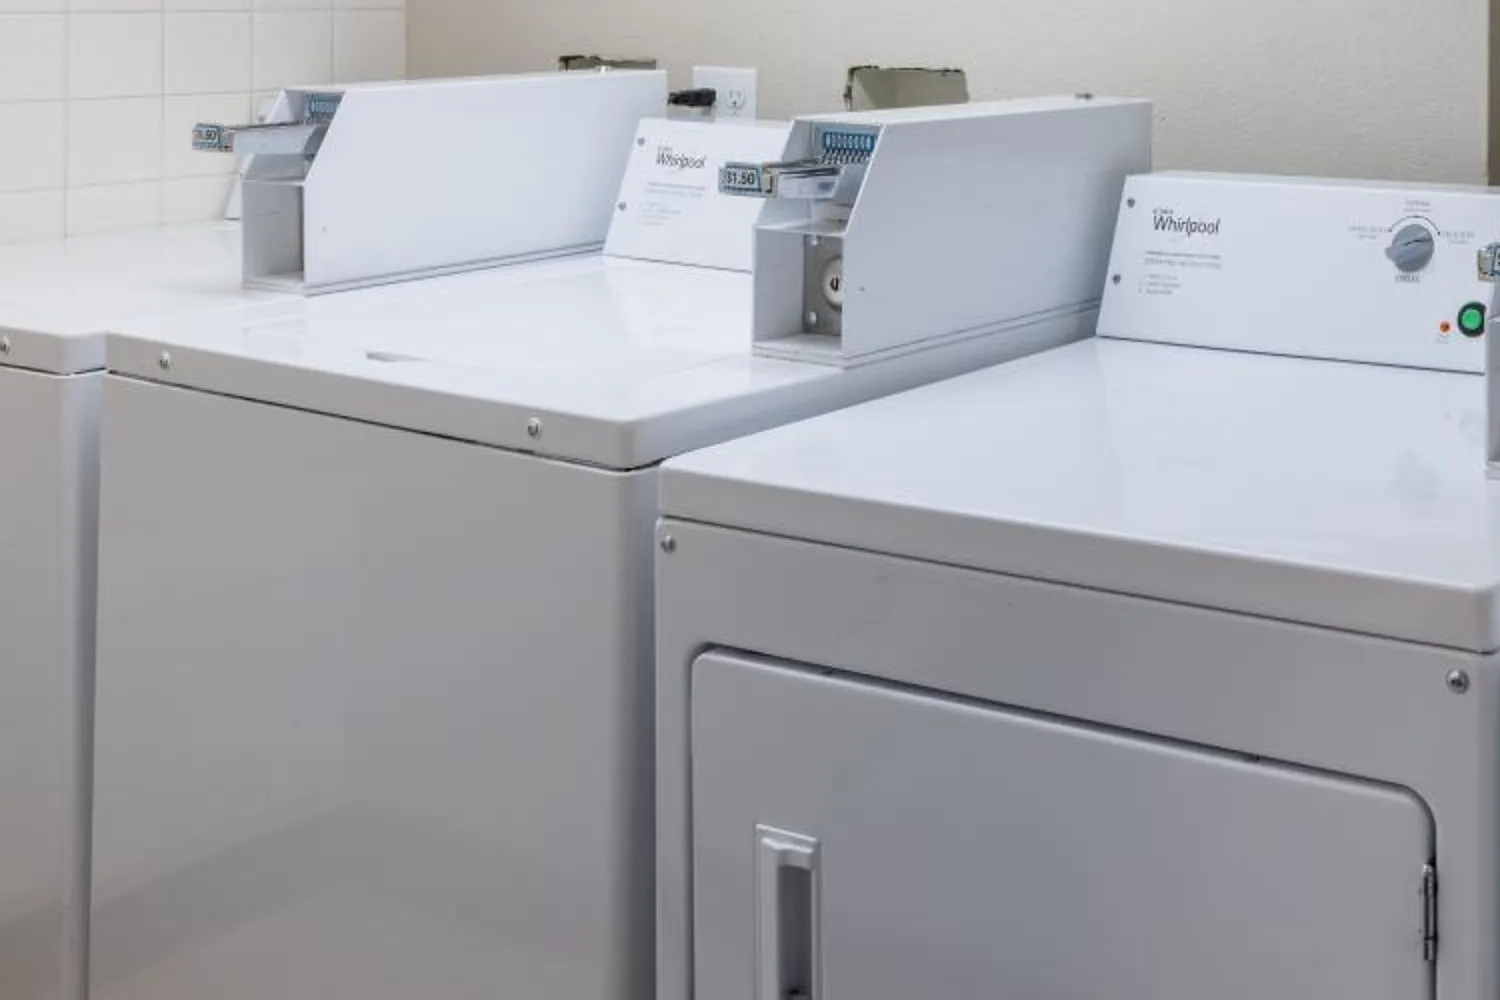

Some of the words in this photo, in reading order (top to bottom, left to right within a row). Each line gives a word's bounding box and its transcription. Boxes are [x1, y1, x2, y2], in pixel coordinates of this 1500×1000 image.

[656, 151, 707, 171] Whirlpool
[726, 172, 756, 186] $1.50
[1152, 215, 1221, 238] Whirlpool
